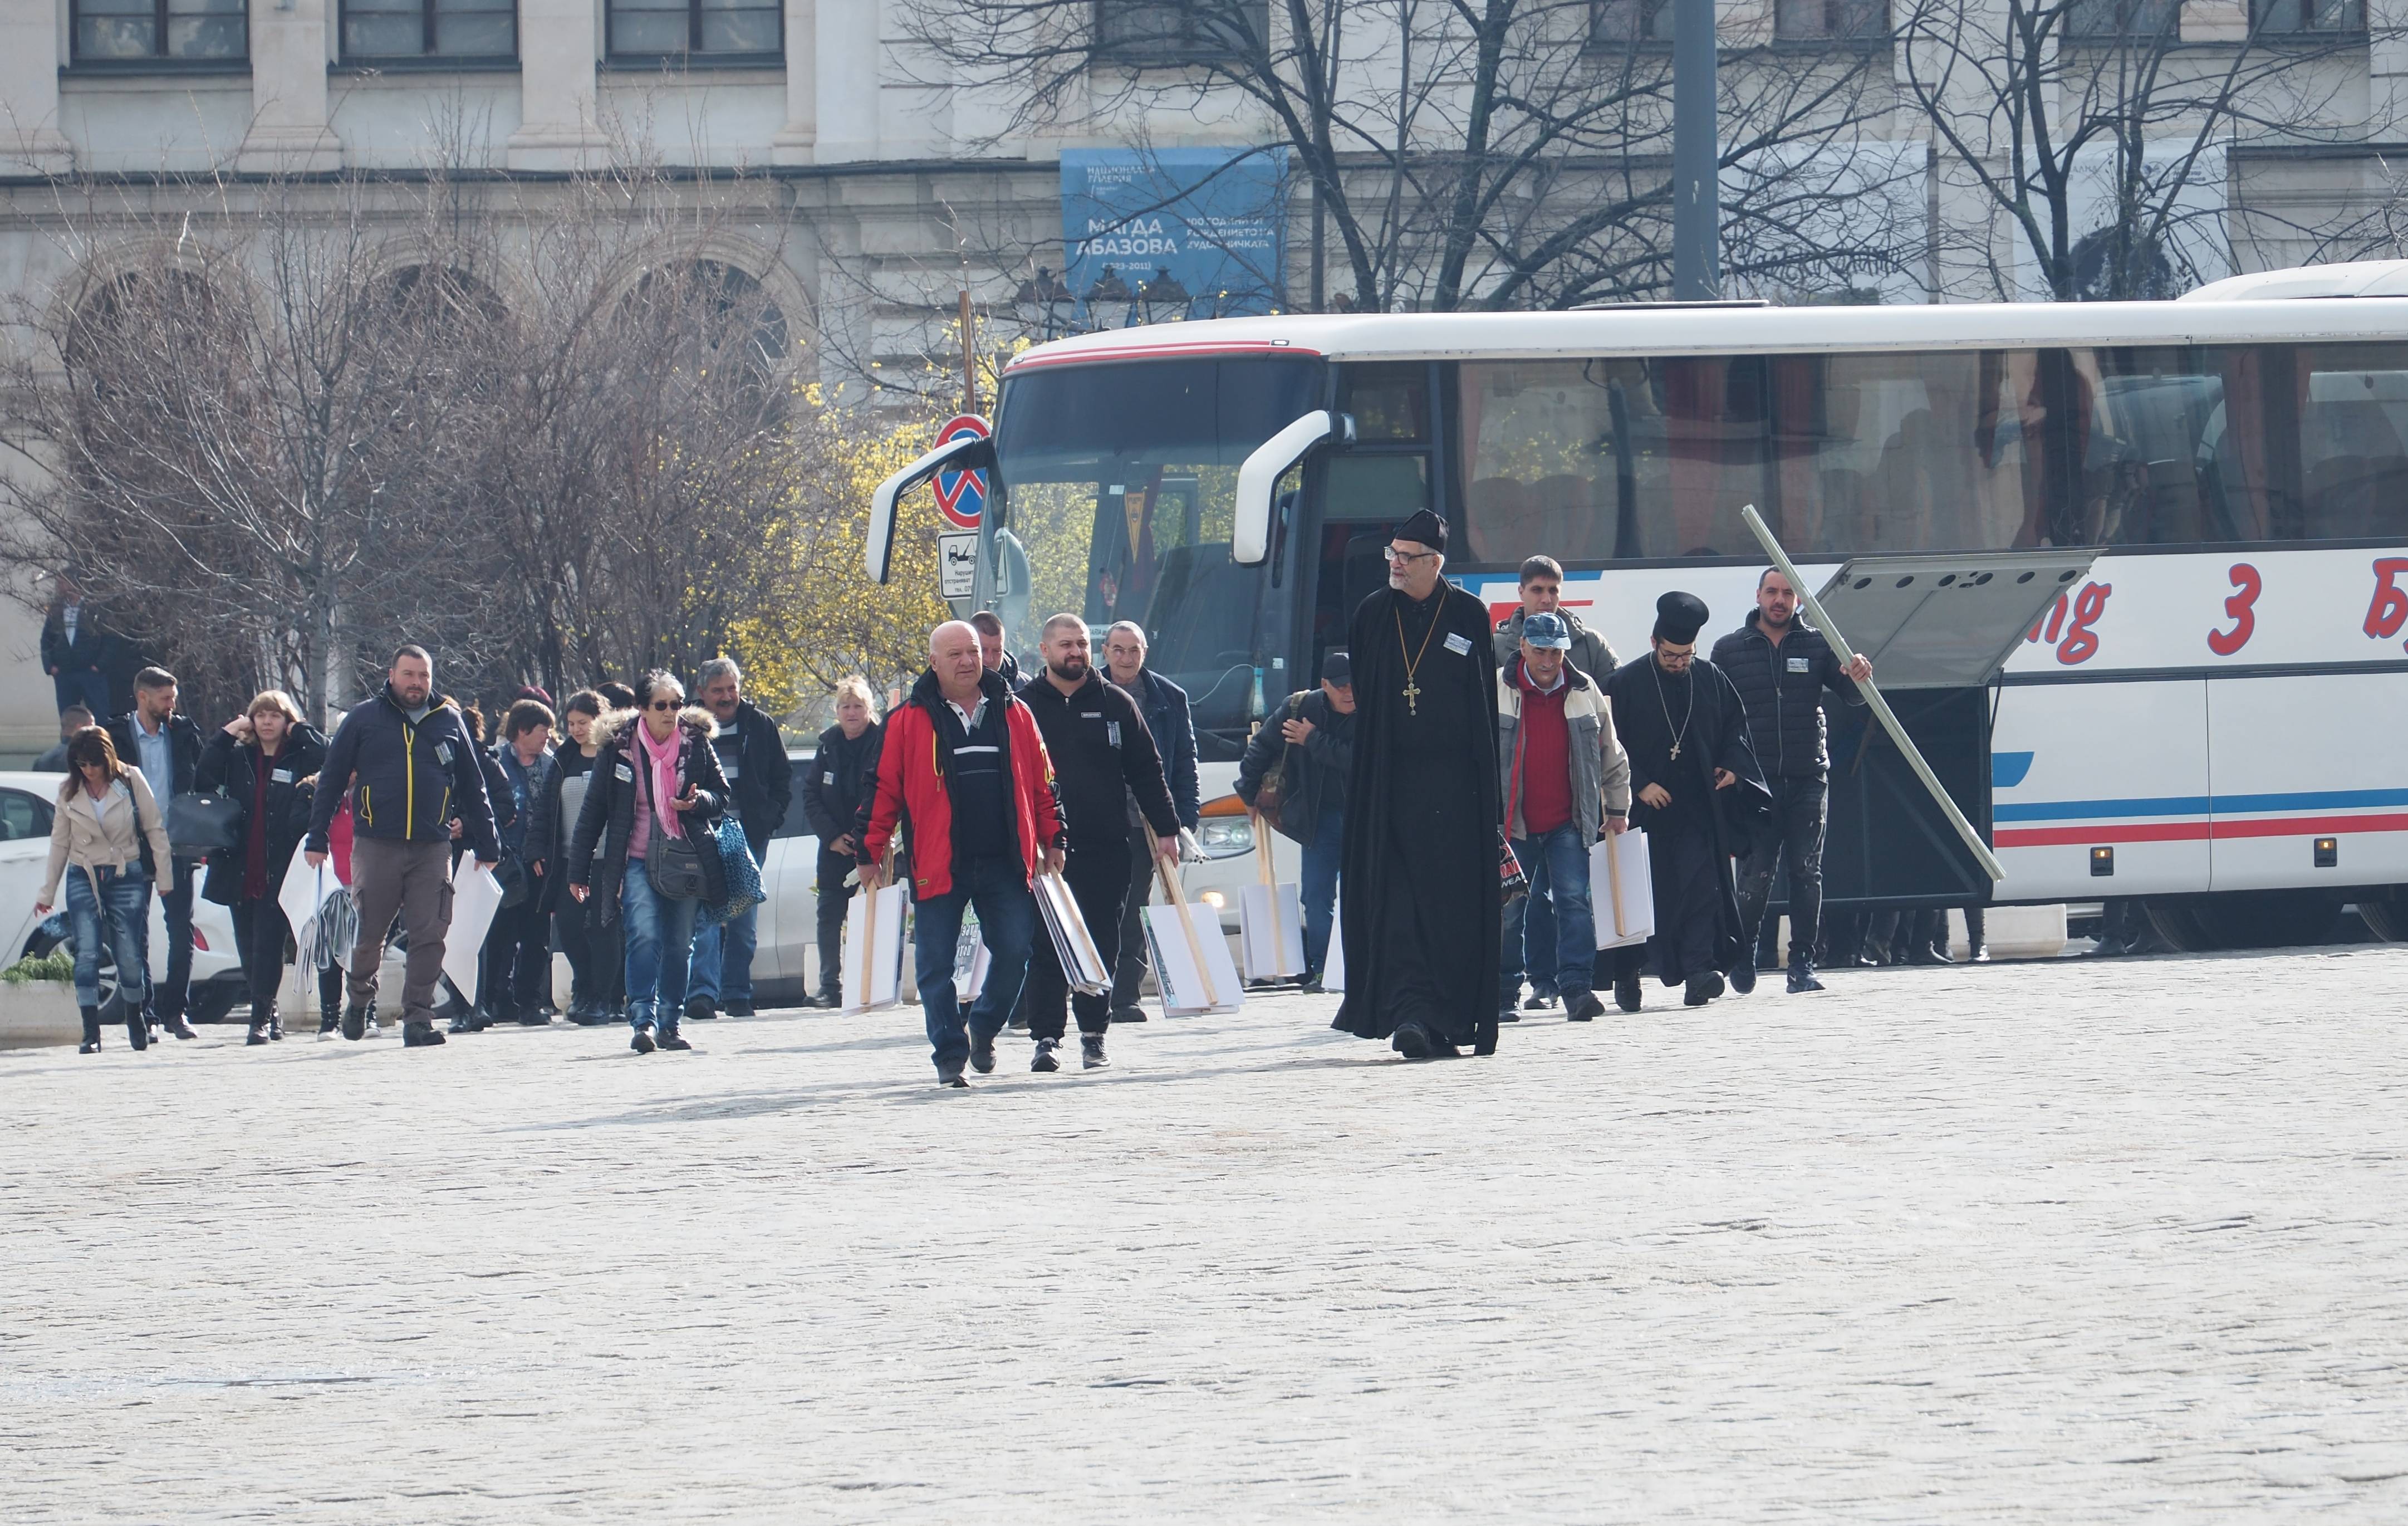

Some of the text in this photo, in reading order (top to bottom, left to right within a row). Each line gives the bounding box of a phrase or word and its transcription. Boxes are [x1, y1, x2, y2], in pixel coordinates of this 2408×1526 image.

[1088, 218, 1163, 238] МАГДА
[1076, 238, 1178, 256] АБАЗОВА
[1102, 261, 1151, 271] (23-2011)
